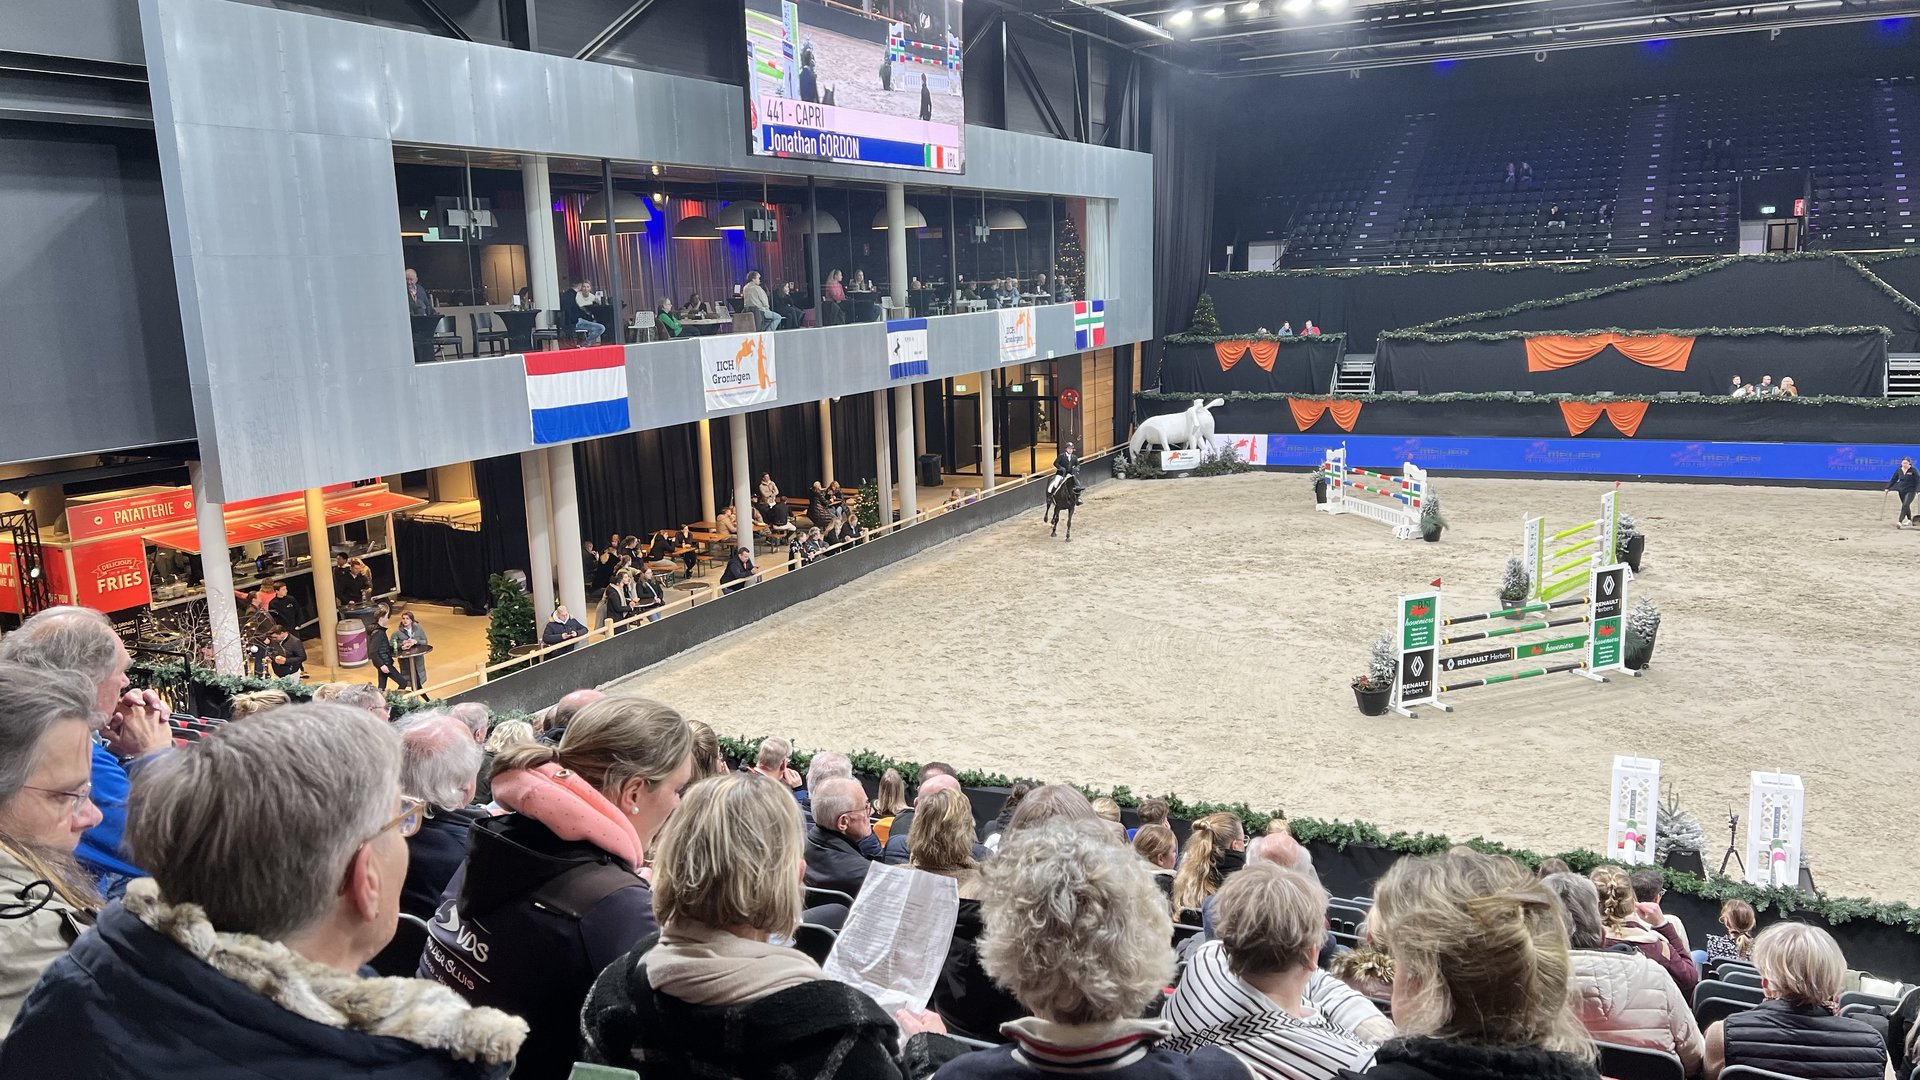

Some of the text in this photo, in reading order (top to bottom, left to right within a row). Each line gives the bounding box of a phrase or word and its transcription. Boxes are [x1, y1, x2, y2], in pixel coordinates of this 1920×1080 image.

[1771, 28, 1781, 40] P
[1350, 68, 1360, 79] N
[767, 100, 784, 122] 441
[796, 105, 825, 128] CAPRI
[768, 127, 860, 159] Jonathan GORDON
[947, 152, 957, 168] IRL
[716, 360, 734, 371] IICH
[712, 373, 751, 384] Groningen
[114, 502, 175, 524] PATATTERIE
[101, 560, 133, 571] DELICIOUS
[97, 571, 142, 594] FRIES
[1405, 617, 1434, 627] hoveniers
[1545, 641, 1574, 652] hoveniers
[1457, 652, 1511, 667] RENAULT Herbers
[1402, 680, 1429, 689] RENAULT
[456, 925, 489, 962] VDS
[431, 947, 445, 967] DER
[445, 959, 475, 990] SLUIS
